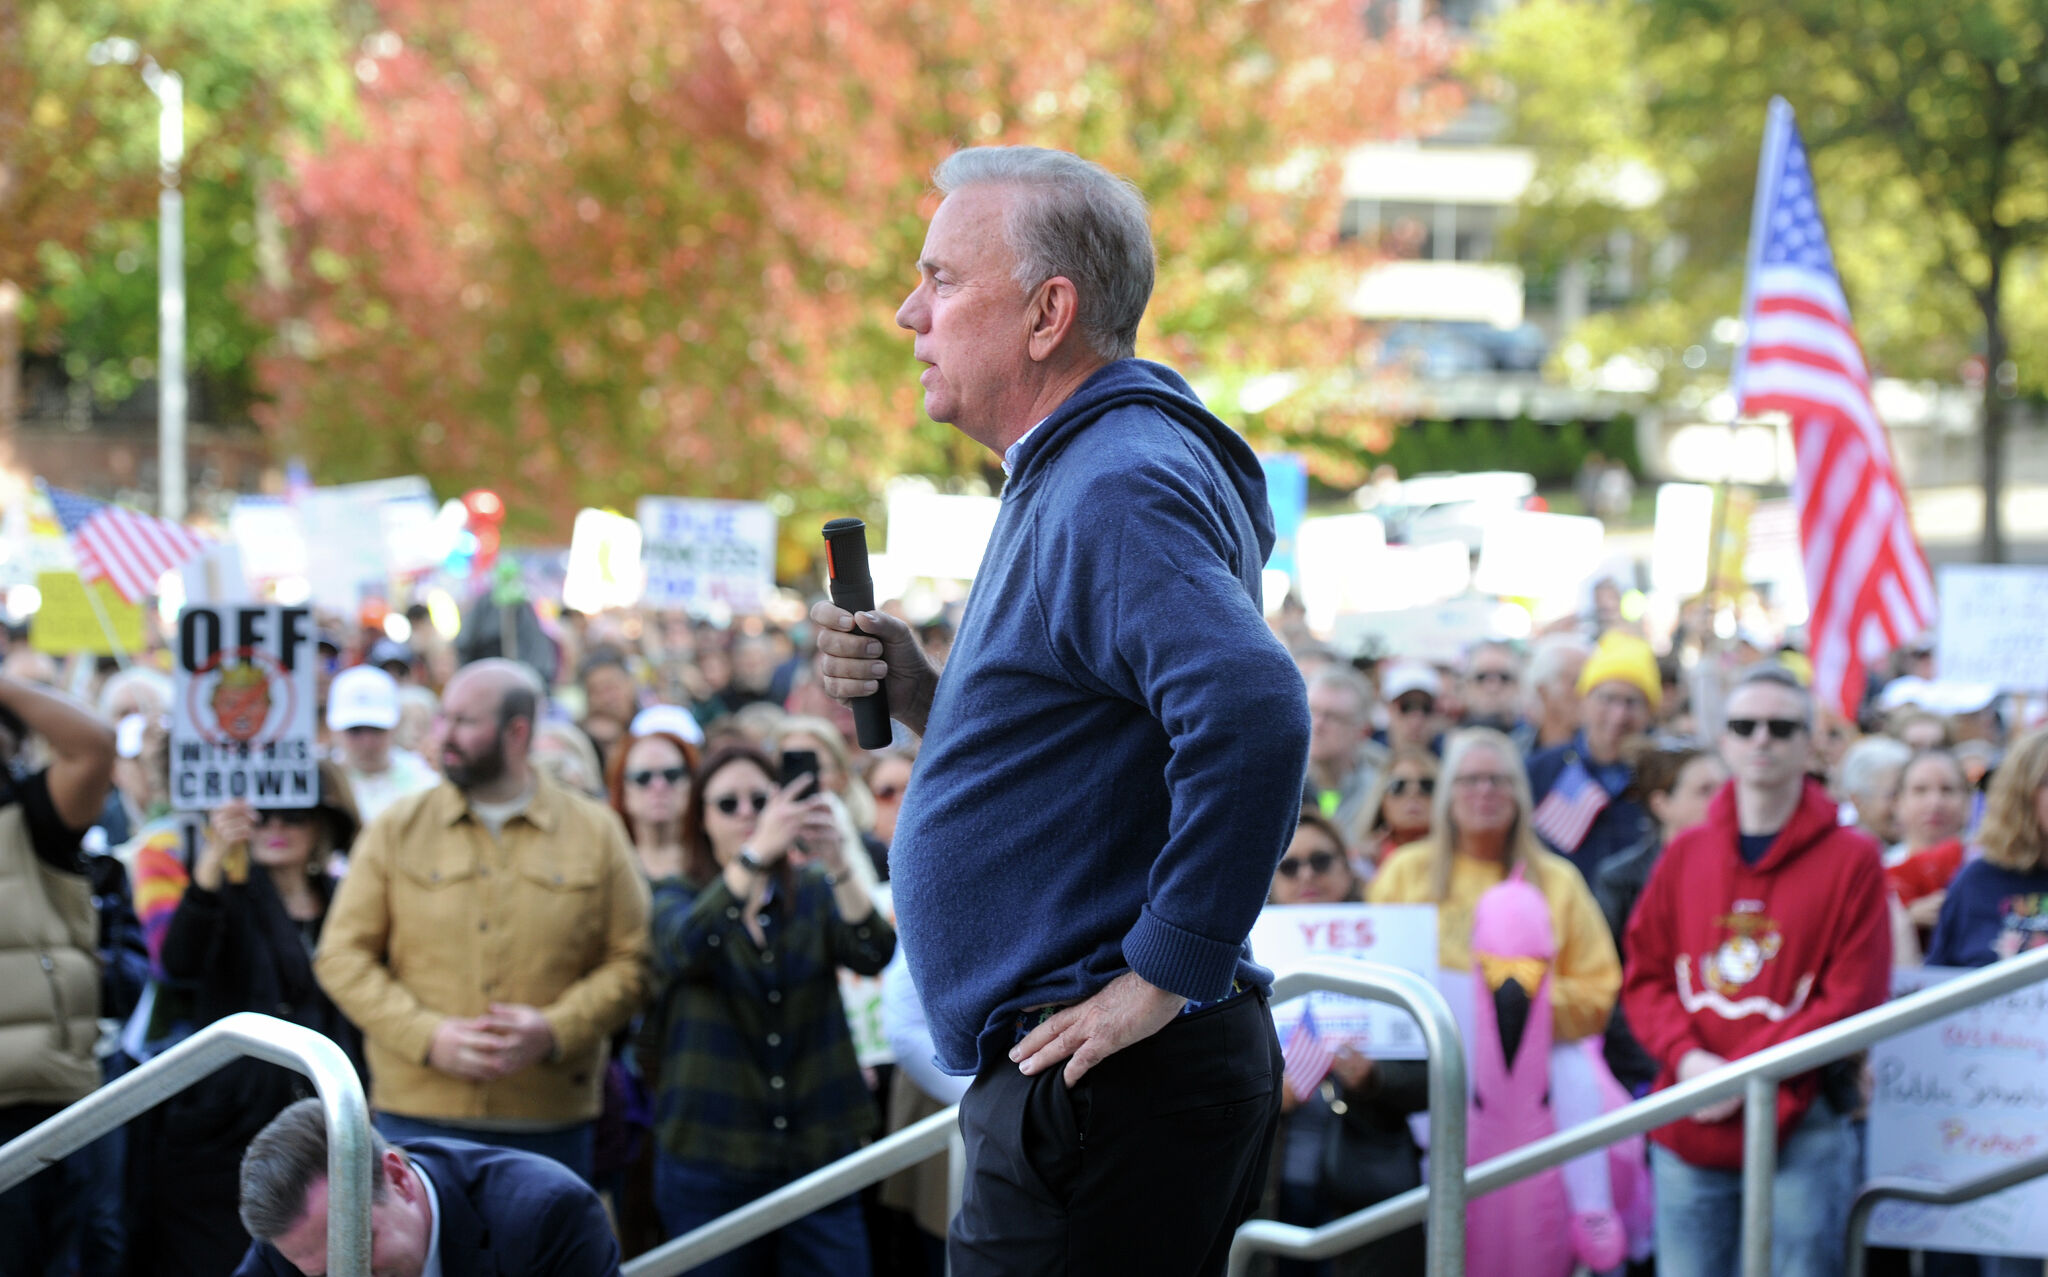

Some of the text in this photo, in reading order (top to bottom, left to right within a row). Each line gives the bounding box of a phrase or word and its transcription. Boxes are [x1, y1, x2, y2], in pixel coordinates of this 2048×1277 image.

[182, 609, 309, 672] OFF
[181, 740, 309, 762] WITH HIS
[180, 771, 309, 797] CROWN
[1298, 918, 1377, 949] YES
